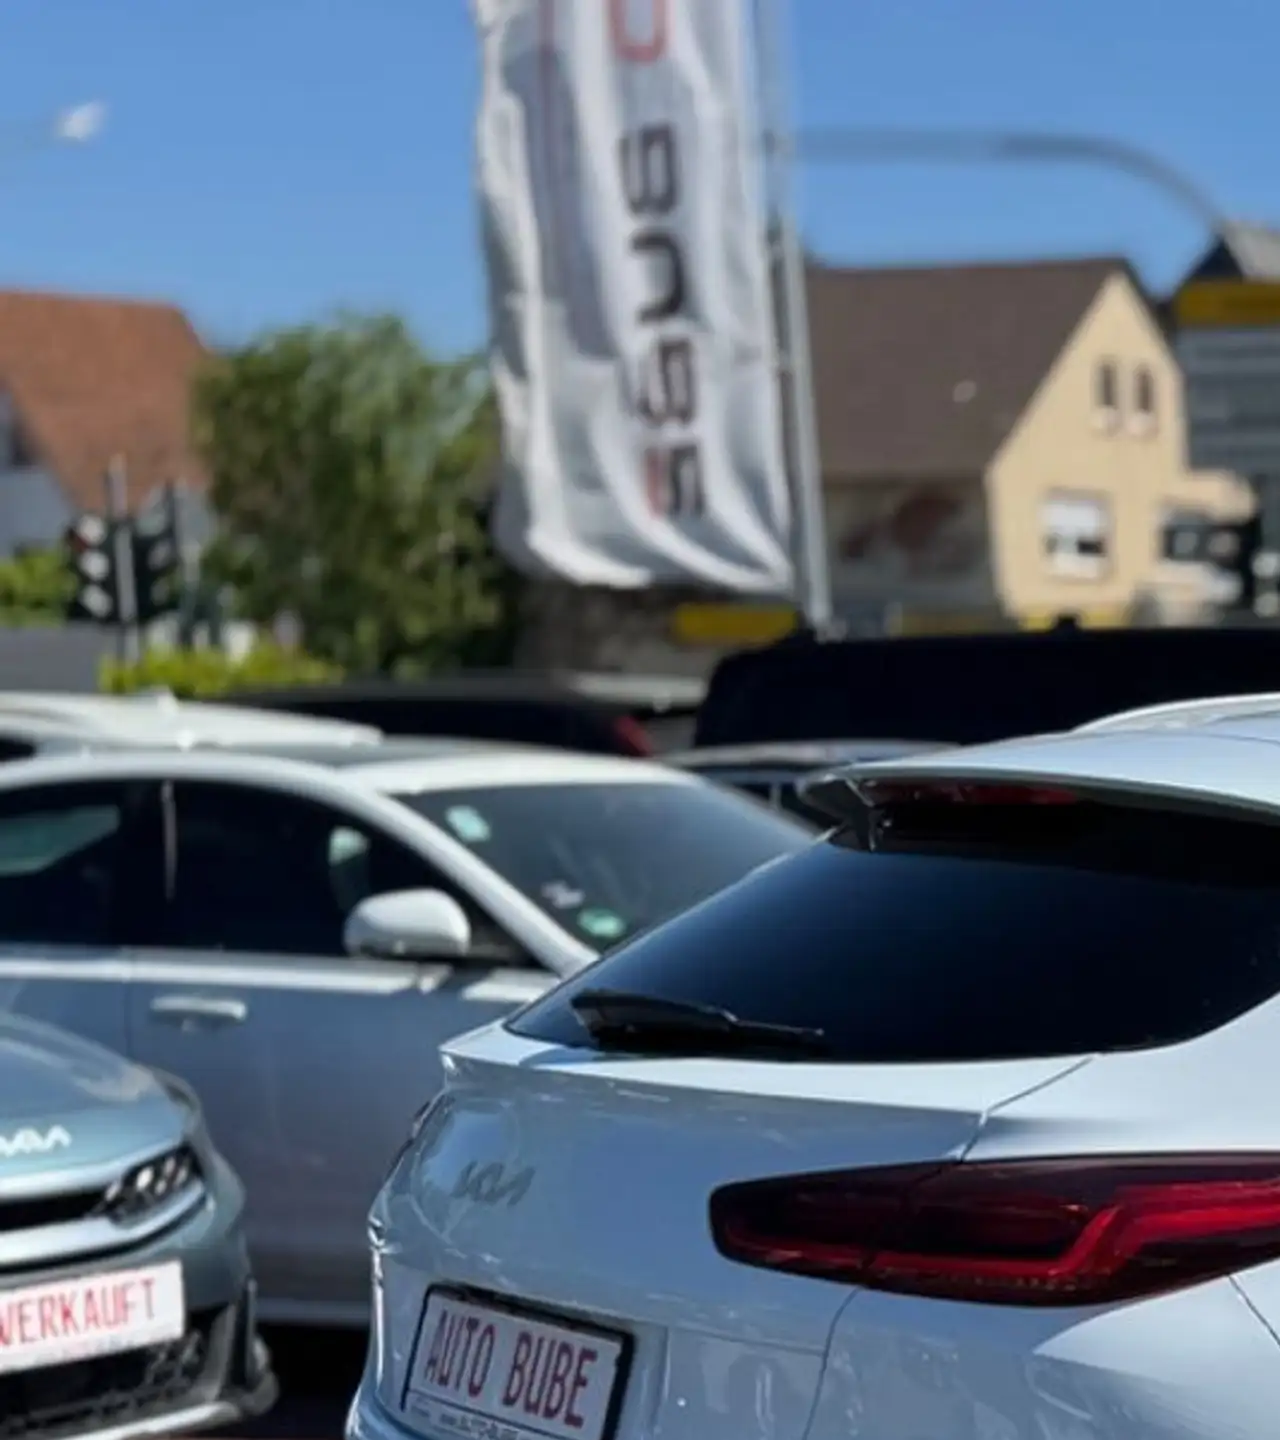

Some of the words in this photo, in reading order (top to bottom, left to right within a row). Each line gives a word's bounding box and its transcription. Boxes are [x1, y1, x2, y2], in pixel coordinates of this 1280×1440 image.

[0, 1277, 156, 1346] VERKAUFT
[423, 1309, 496, 1398] AUTO
[501, 1331, 598, 1429] BUBE
